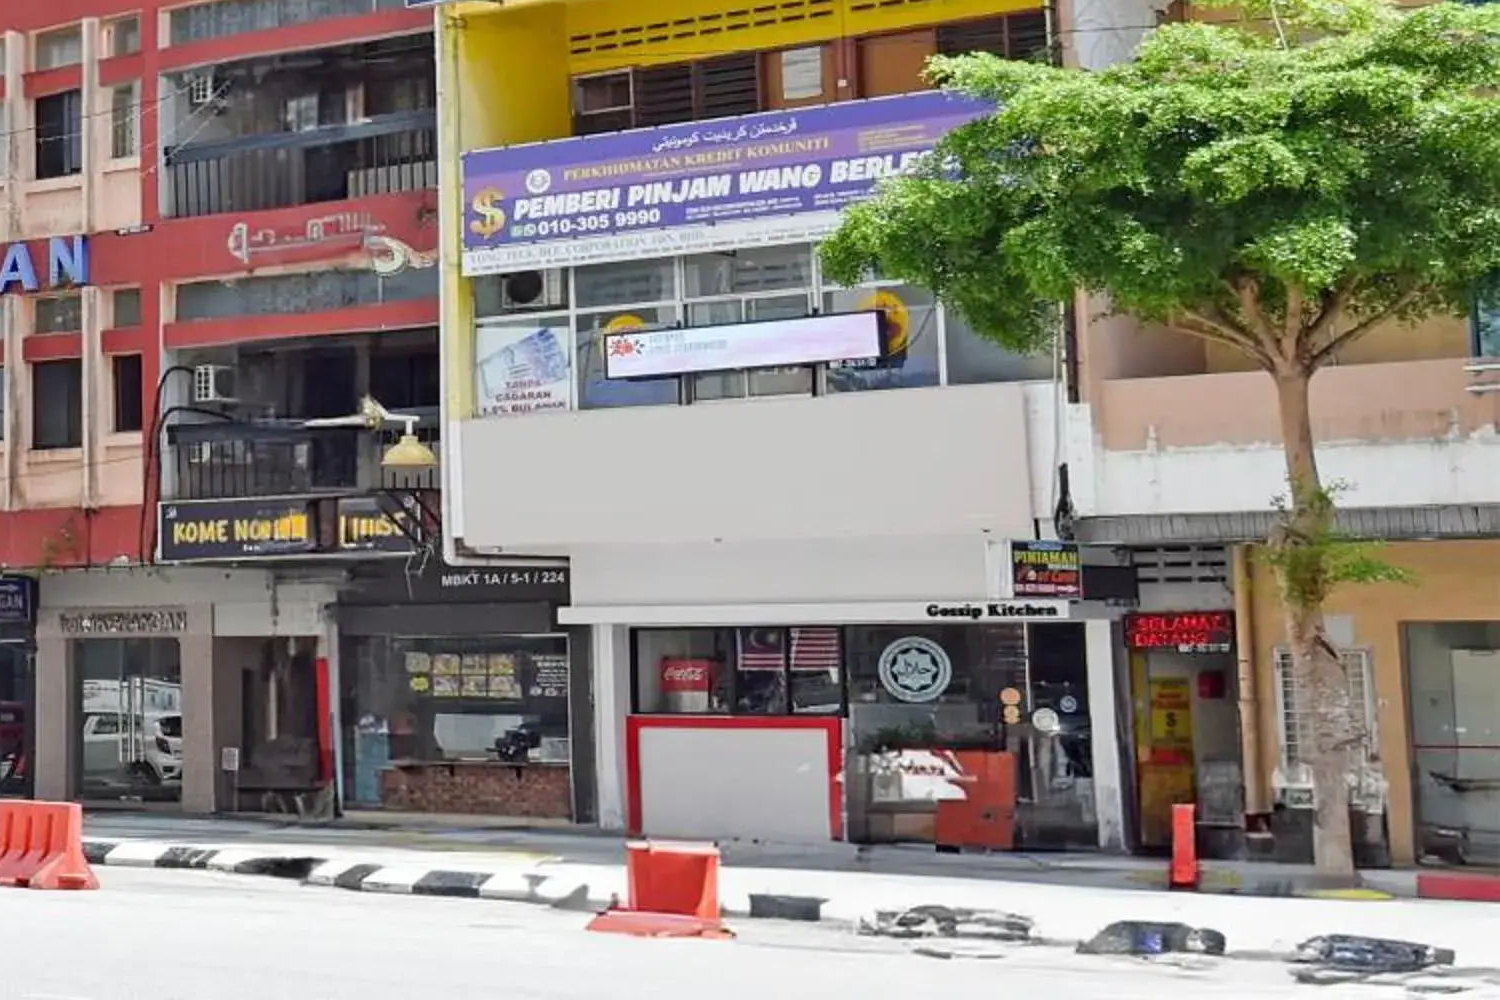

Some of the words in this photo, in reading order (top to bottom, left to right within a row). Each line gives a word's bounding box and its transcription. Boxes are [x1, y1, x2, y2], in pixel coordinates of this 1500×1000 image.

[564, 155, 680, 182] PERKHIDMATAN
[685, 148, 741, 169] KREDIT
[747, 136, 828, 159] KOMUNITI
[513, 187, 620, 221] PEMBERI
[628, 172, 732, 207] PINJAM
[739, 163, 821, 194] WANG
[538, 214, 609, 236] 010-305
[615, 208, 661, 228] 9990
[173, 519, 228, 544] KOME
[441, 573, 480, 587] MBKT
[483, 573, 500, 585] 1A
[511, 573, 530, 584] 5-1
[542, 572, 565, 583] 224
[926, 603, 983, 619] Gossip
[988, 603, 1058, 617] Kitchen
[1137, 616, 1222, 631] SELAMAT
[1135, 632, 1207, 647] DATANG
